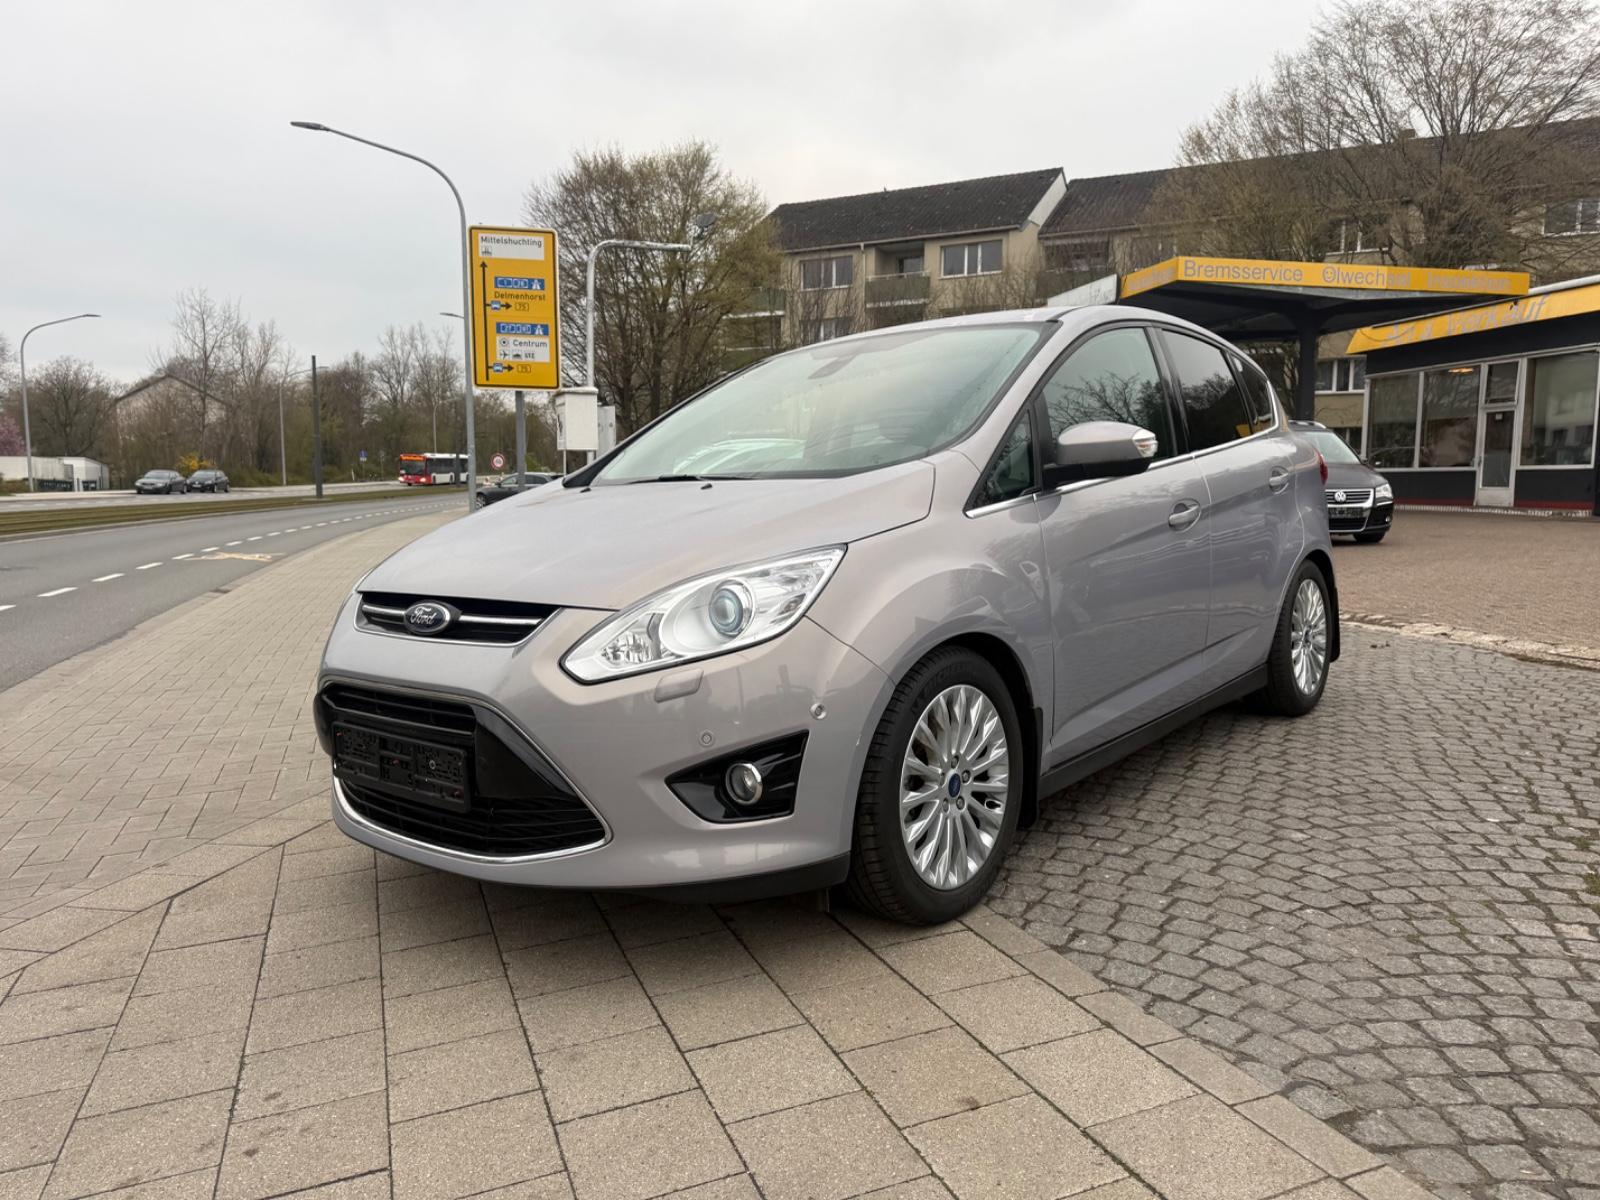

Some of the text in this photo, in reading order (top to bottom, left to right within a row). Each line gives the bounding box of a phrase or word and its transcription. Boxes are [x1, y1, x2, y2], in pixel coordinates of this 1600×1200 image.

[1184, 259, 1304, 281] Bremsservice
[494, 291, 546, 301] Delmenhorst
[513, 340, 548, 348] Centrum
[410, 606, 438, 625] Ford
